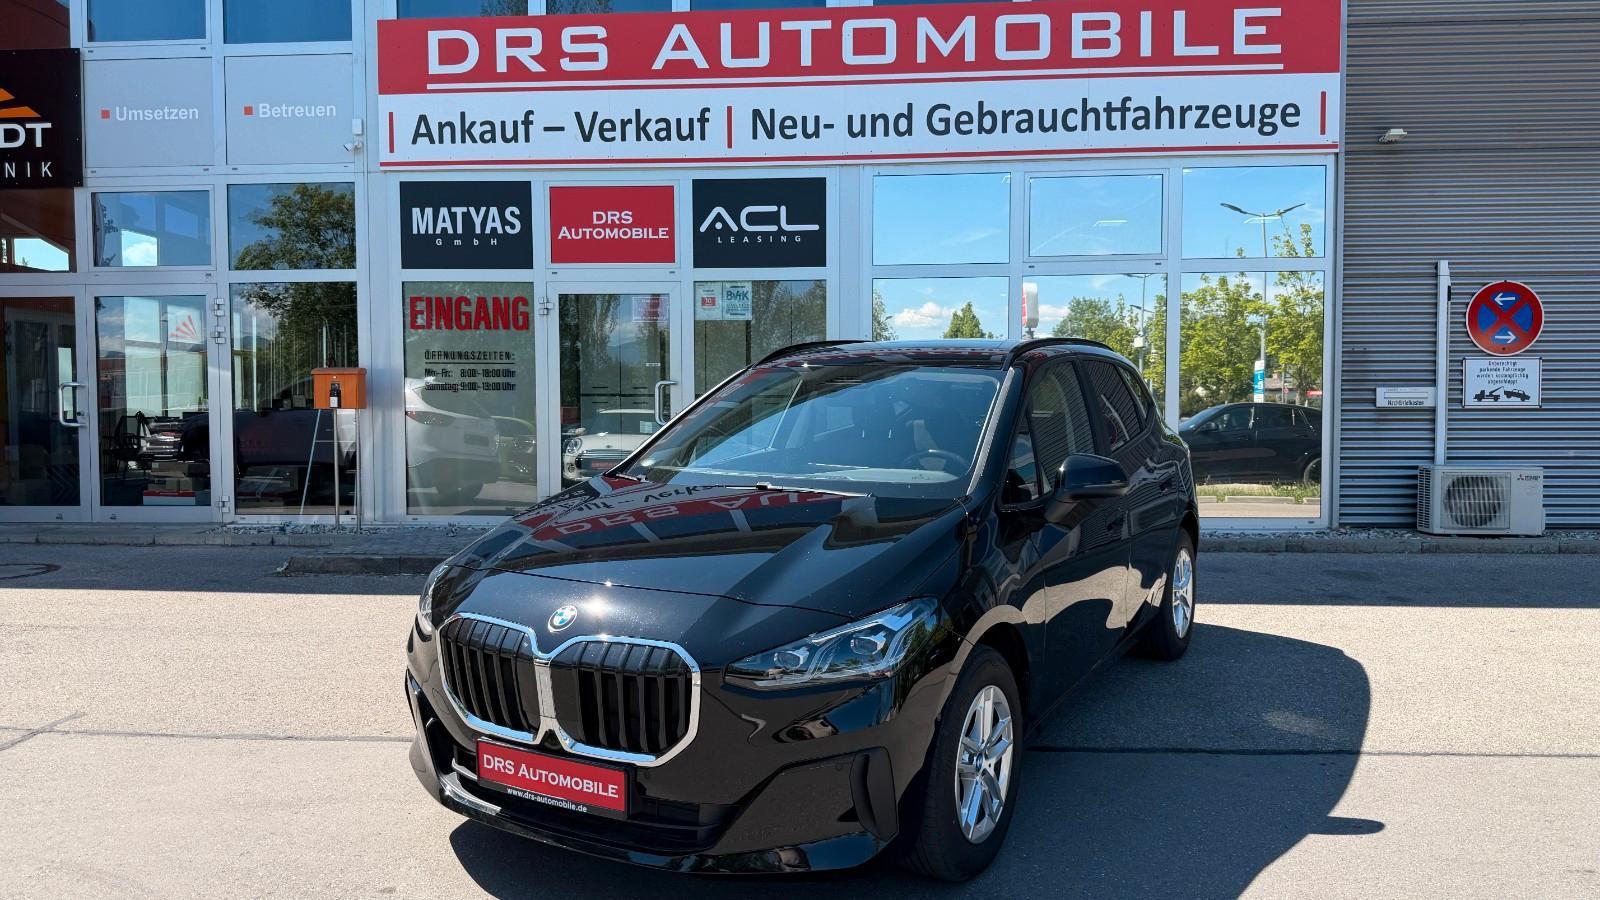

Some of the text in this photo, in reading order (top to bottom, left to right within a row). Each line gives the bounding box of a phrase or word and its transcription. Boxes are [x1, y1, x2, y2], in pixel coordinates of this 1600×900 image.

[427, 7, 1282, 75] DRS AUTOMOBILE
[115, 105, 199, 122] Umsetzen
[258, 103, 337, 119] Betreuen
[412, 110, 534, 145] Ankauf
[574, 107, 710, 143] Verkauf
[751, 108, 835, 140] Neu-
[847, 103, 913, 138] und
[926, 95, 1301, 137] Gebrauchtfahrzeuge
[411, 206, 521, 235] MATYAS
[592, 211, 633, 225] DRS
[699, 205, 820, 233] ACL
[435, 238, 498, 247] GmbH
[557, 226, 670, 240] AUTOMOBILE
[717, 235, 802, 244] LEASING
[409, 295, 530, 331] EINGANG
[483, 754, 619, 798] DRS AUTOMOBILE
[507, 787, 588, 813] www.drs-automobile.de
